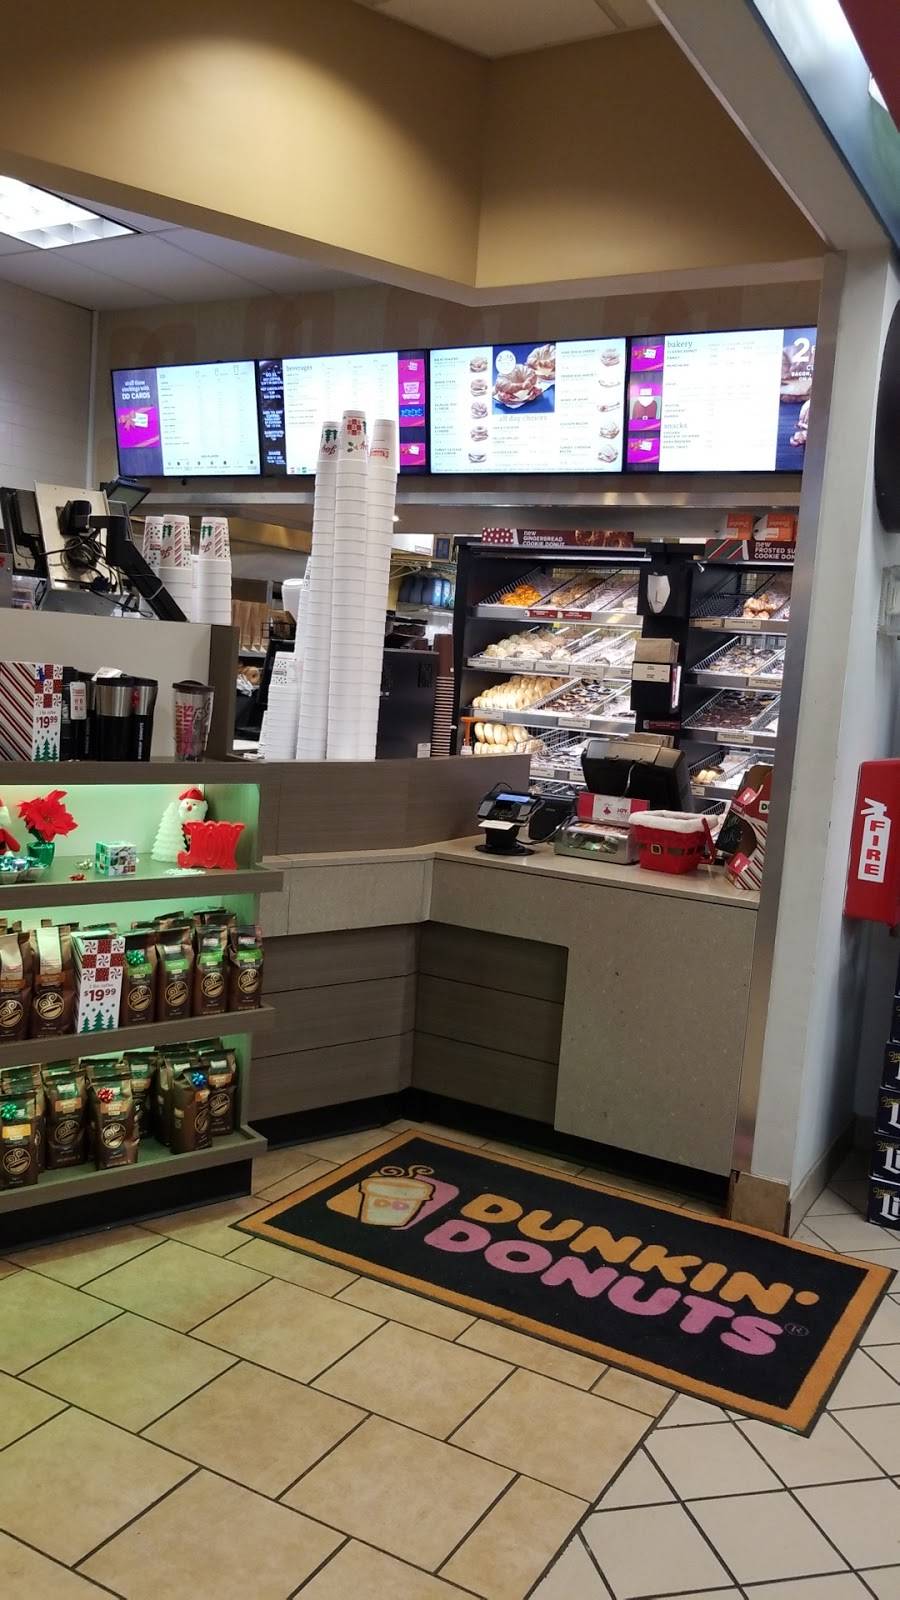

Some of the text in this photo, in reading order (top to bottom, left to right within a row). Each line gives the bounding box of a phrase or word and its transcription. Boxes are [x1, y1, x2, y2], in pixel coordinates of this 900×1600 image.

[667, 340, 693, 348] bakery
[131, 392, 151, 400] CARDS
[864, 820, 885, 876] FIRE
[424, 1219, 783, 1356] DONUTS
